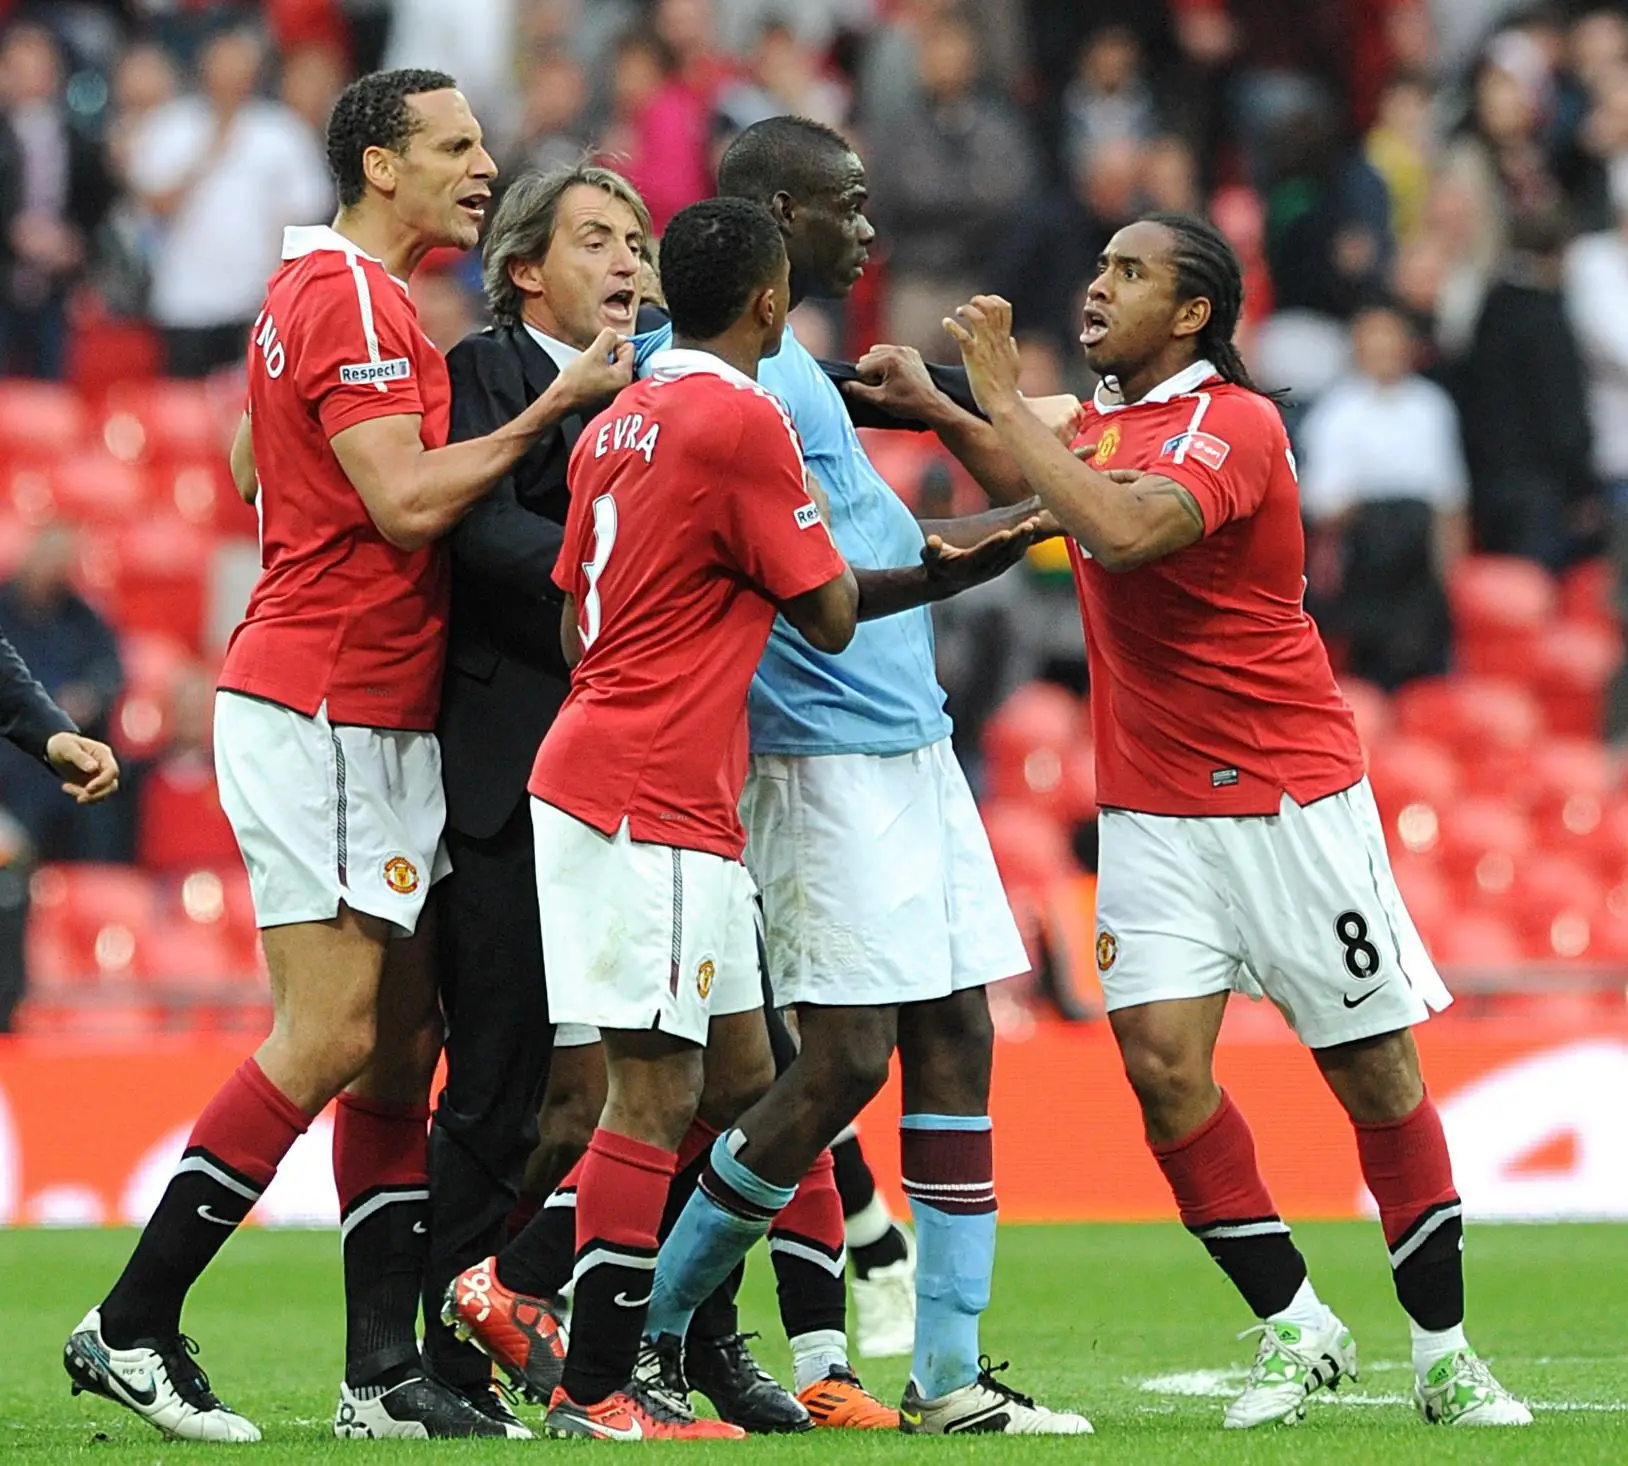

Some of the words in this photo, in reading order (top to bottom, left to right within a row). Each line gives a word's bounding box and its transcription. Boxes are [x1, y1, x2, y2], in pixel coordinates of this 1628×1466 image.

[342, 363, 395, 381] Respect
[594, 413, 661, 464] EVRA
[1333, 909, 1382, 981] 8
